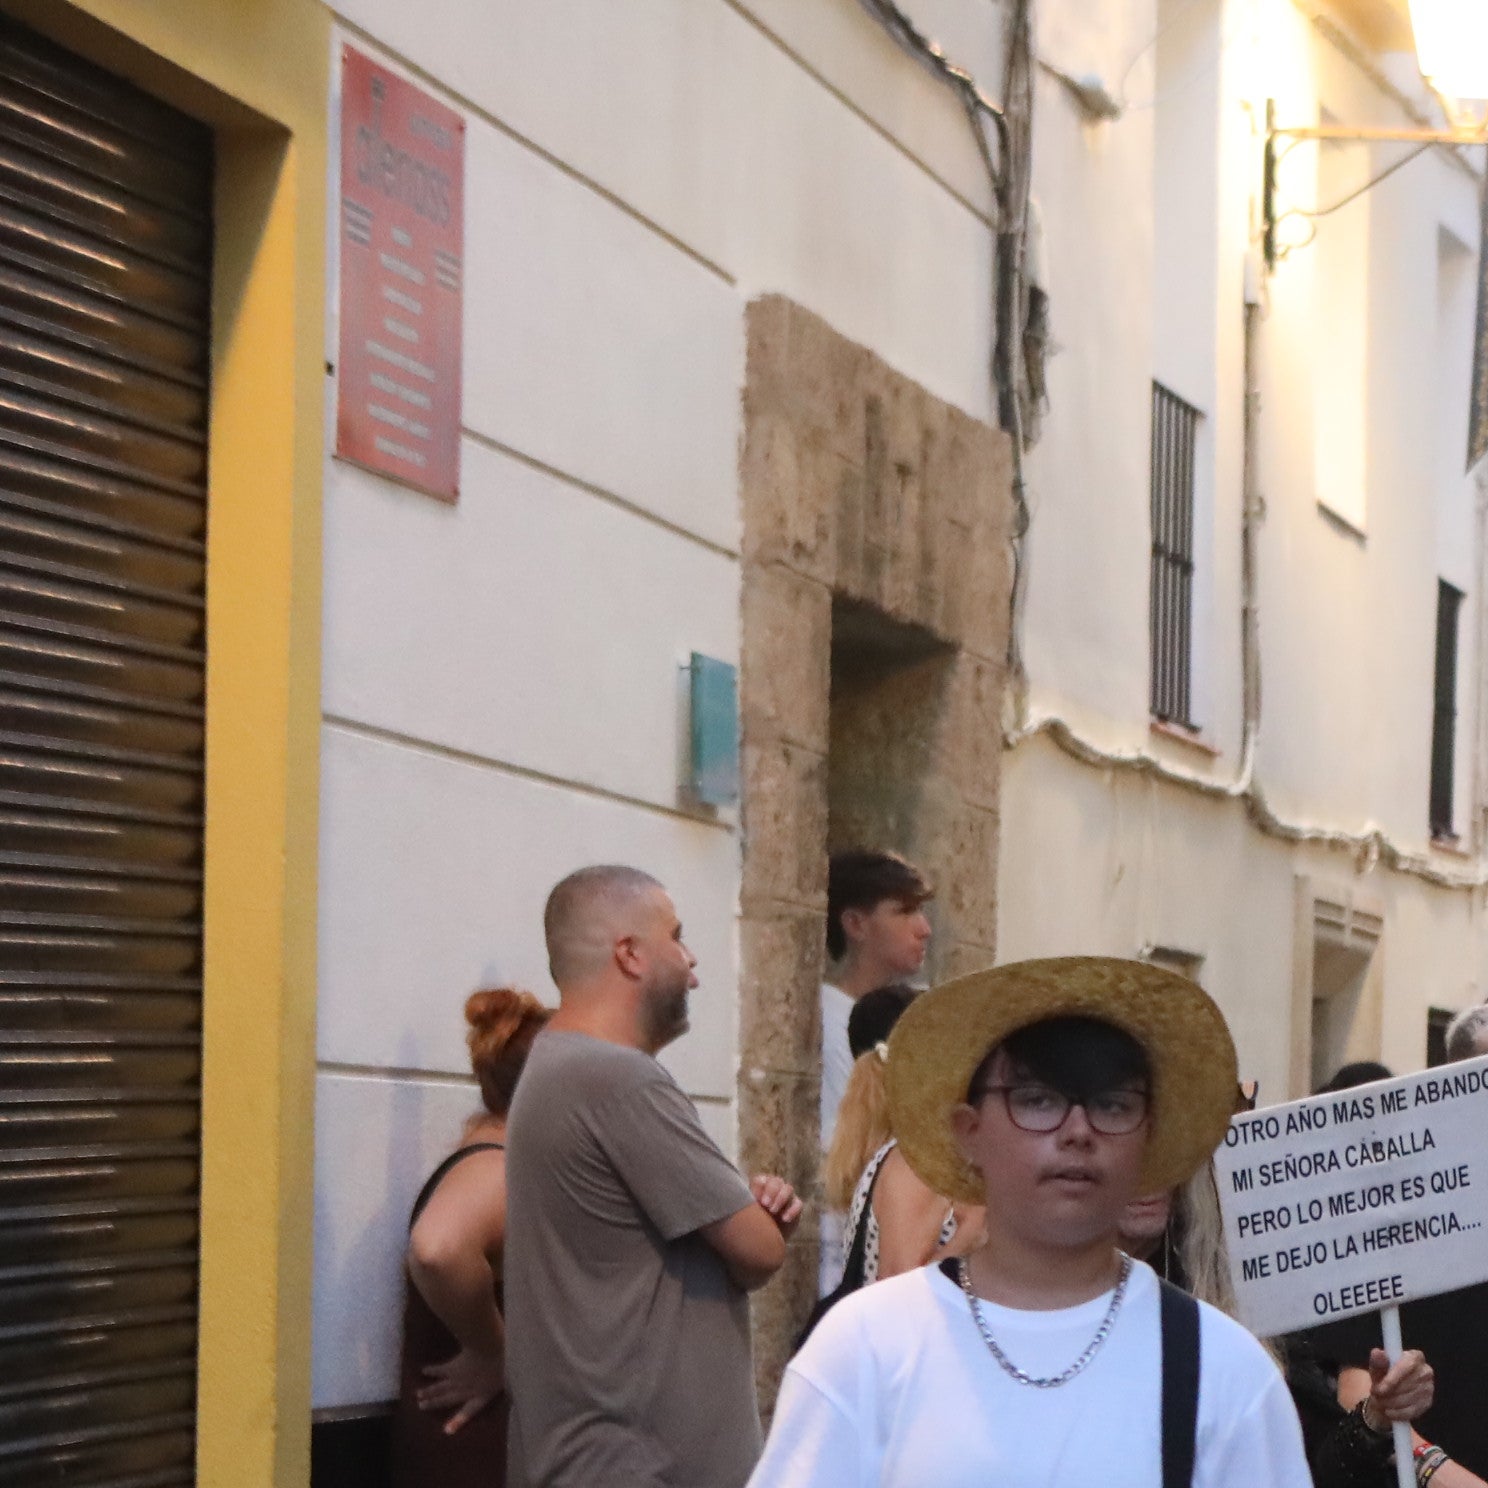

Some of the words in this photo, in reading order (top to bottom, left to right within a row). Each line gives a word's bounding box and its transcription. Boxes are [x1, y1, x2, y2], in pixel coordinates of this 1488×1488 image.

[1225, 1115, 1280, 1148] OTRO
[1285, 1103, 1328, 1135] AÑO
[1333, 1096, 1375, 1126] MAS
[1381, 1088, 1407, 1115] ME
[1232, 1167, 1254, 1193] MI
[1259, 1151, 1341, 1187] SEÑORA
[1345, 1127, 1436, 1168] CABALLA
[1238, 1206, 1292, 1238] PERO
[1297, 1199, 1323, 1224] LO
[1328, 1185, 1396, 1217] MEJOR
[1401, 1177, 1426, 1202] ES
[1431, 1164, 1471, 1196] QUE
[1242, 1256, 1271, 1282] ME
[1276, 1242, 1328, 1274] DEJO
[1333, 1235, 1359, 1260] LA
[1362, 1211, 1482, 1252] HERENCIA....
[1313, 1274, 1404, 1316] OLEEEEE
